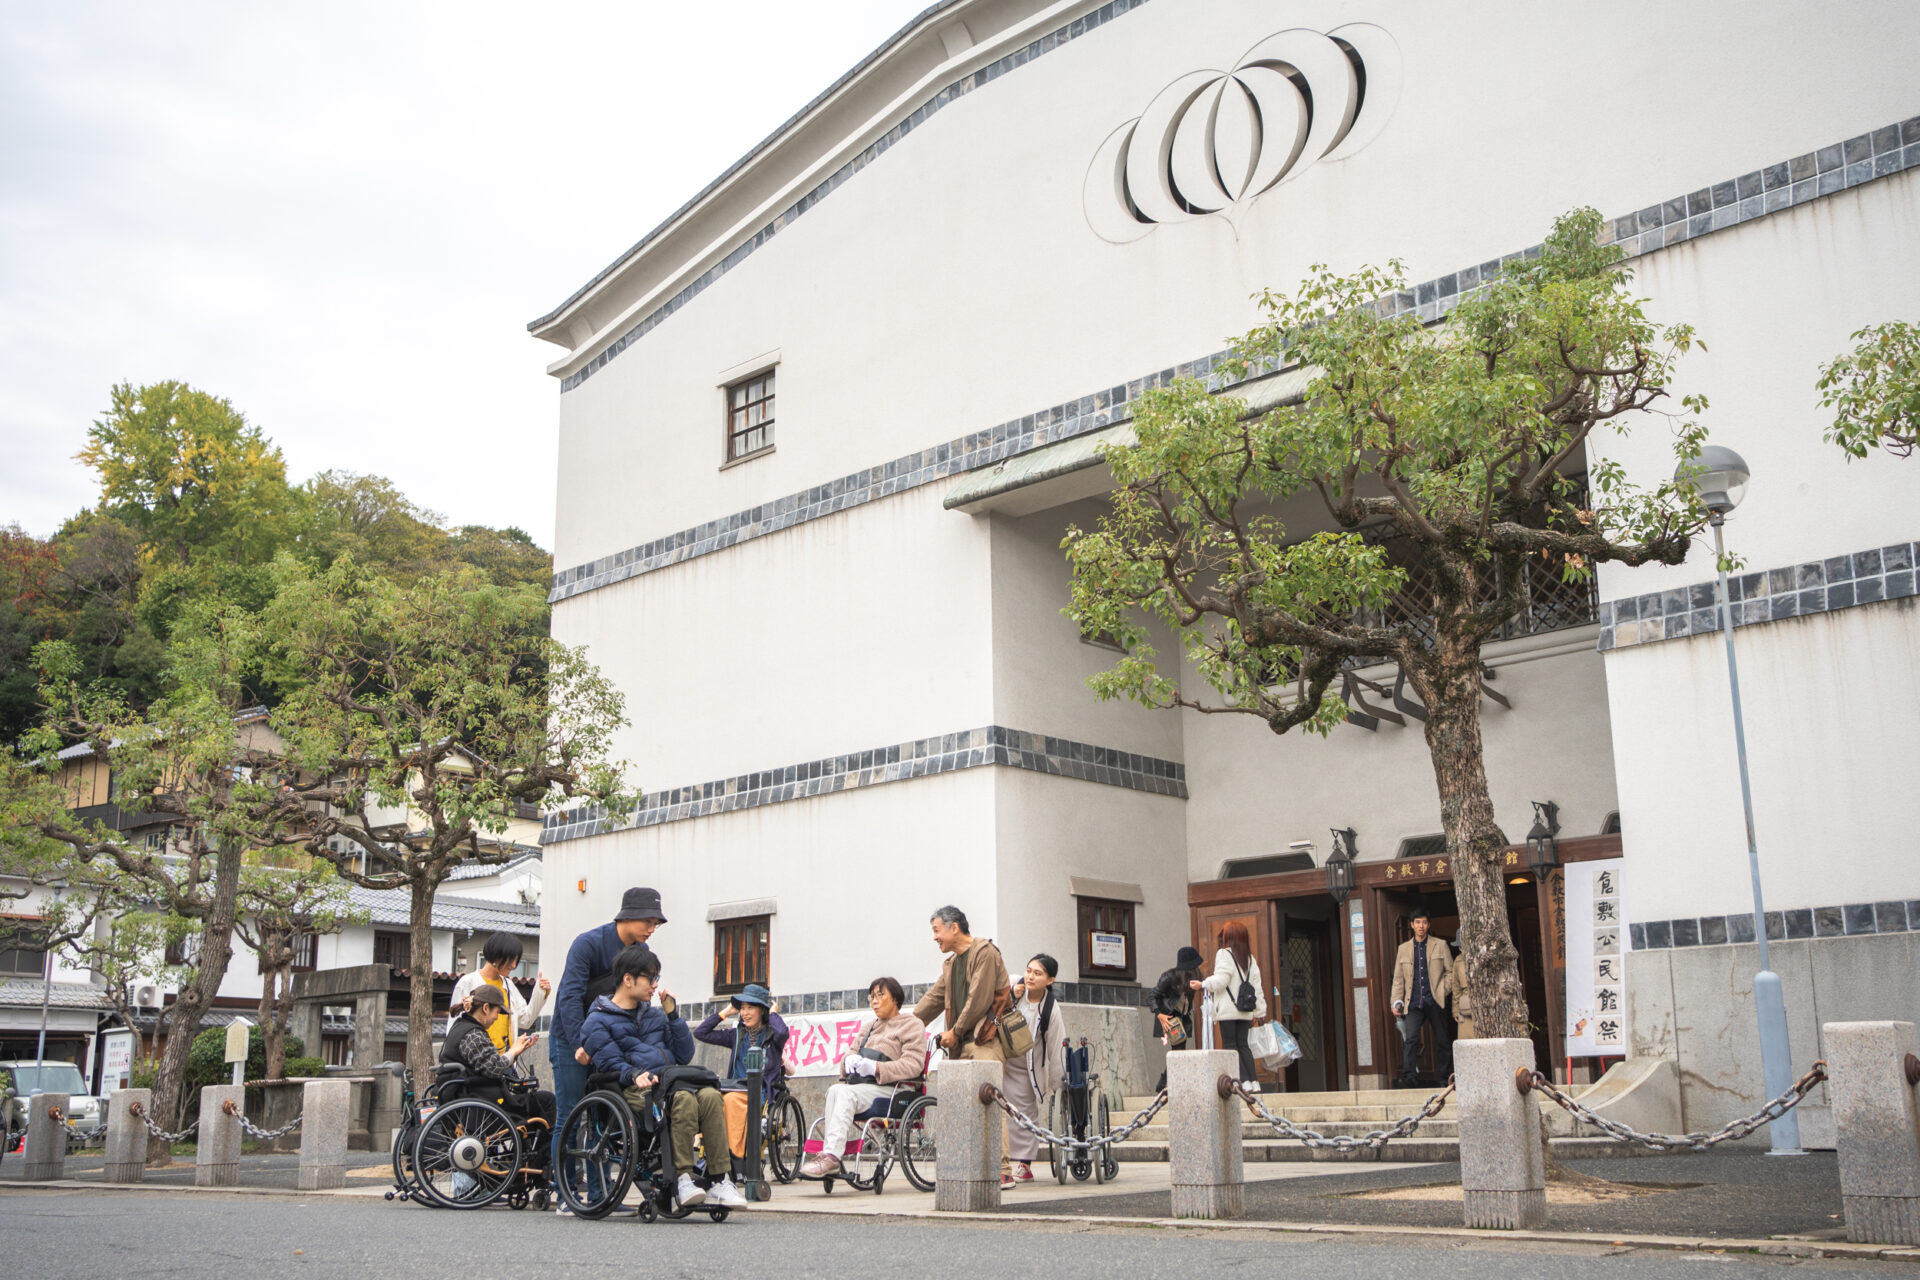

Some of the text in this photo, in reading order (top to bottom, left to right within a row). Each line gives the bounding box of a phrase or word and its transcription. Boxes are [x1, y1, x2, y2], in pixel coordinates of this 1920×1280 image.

[1597, 870, 1618, 1040] 倉敷公民館祭
